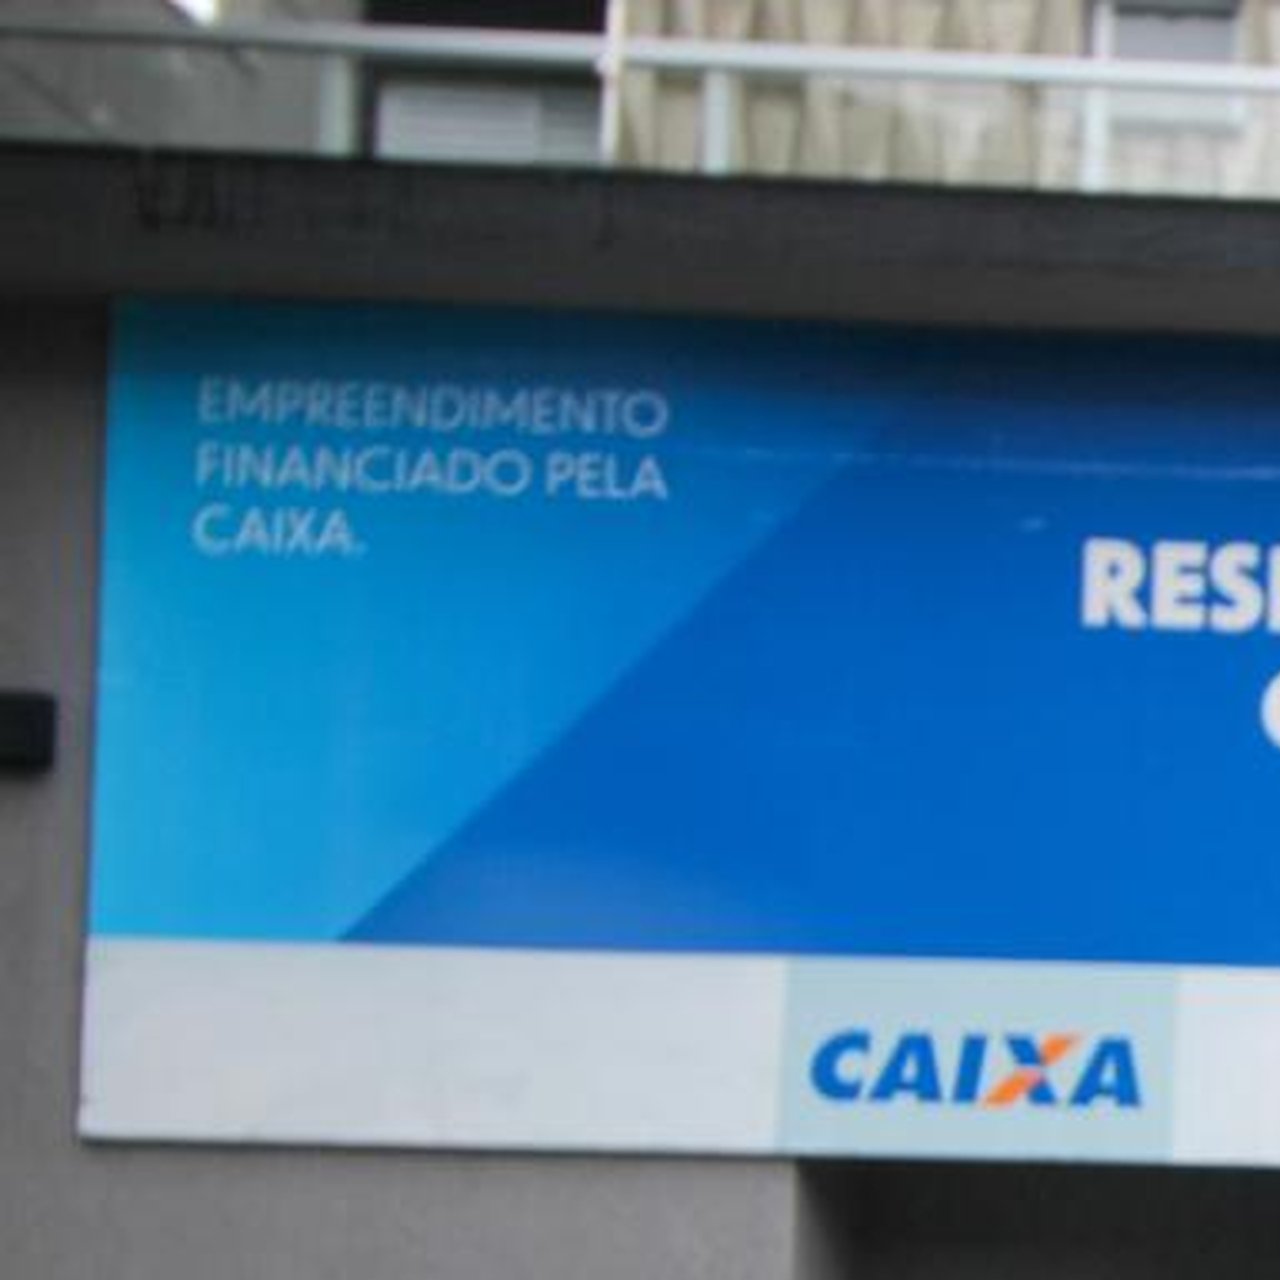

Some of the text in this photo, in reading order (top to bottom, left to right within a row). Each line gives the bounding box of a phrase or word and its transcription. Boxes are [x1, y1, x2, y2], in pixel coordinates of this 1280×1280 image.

[197, 375, 669, 439] EMPREENDIMENTO
[194, 442, 669, 501] FINANCIADO PELA
[191, 504, 367, 556] CAIXA.
[808, 1026, 1143, 1109] CAIXA
